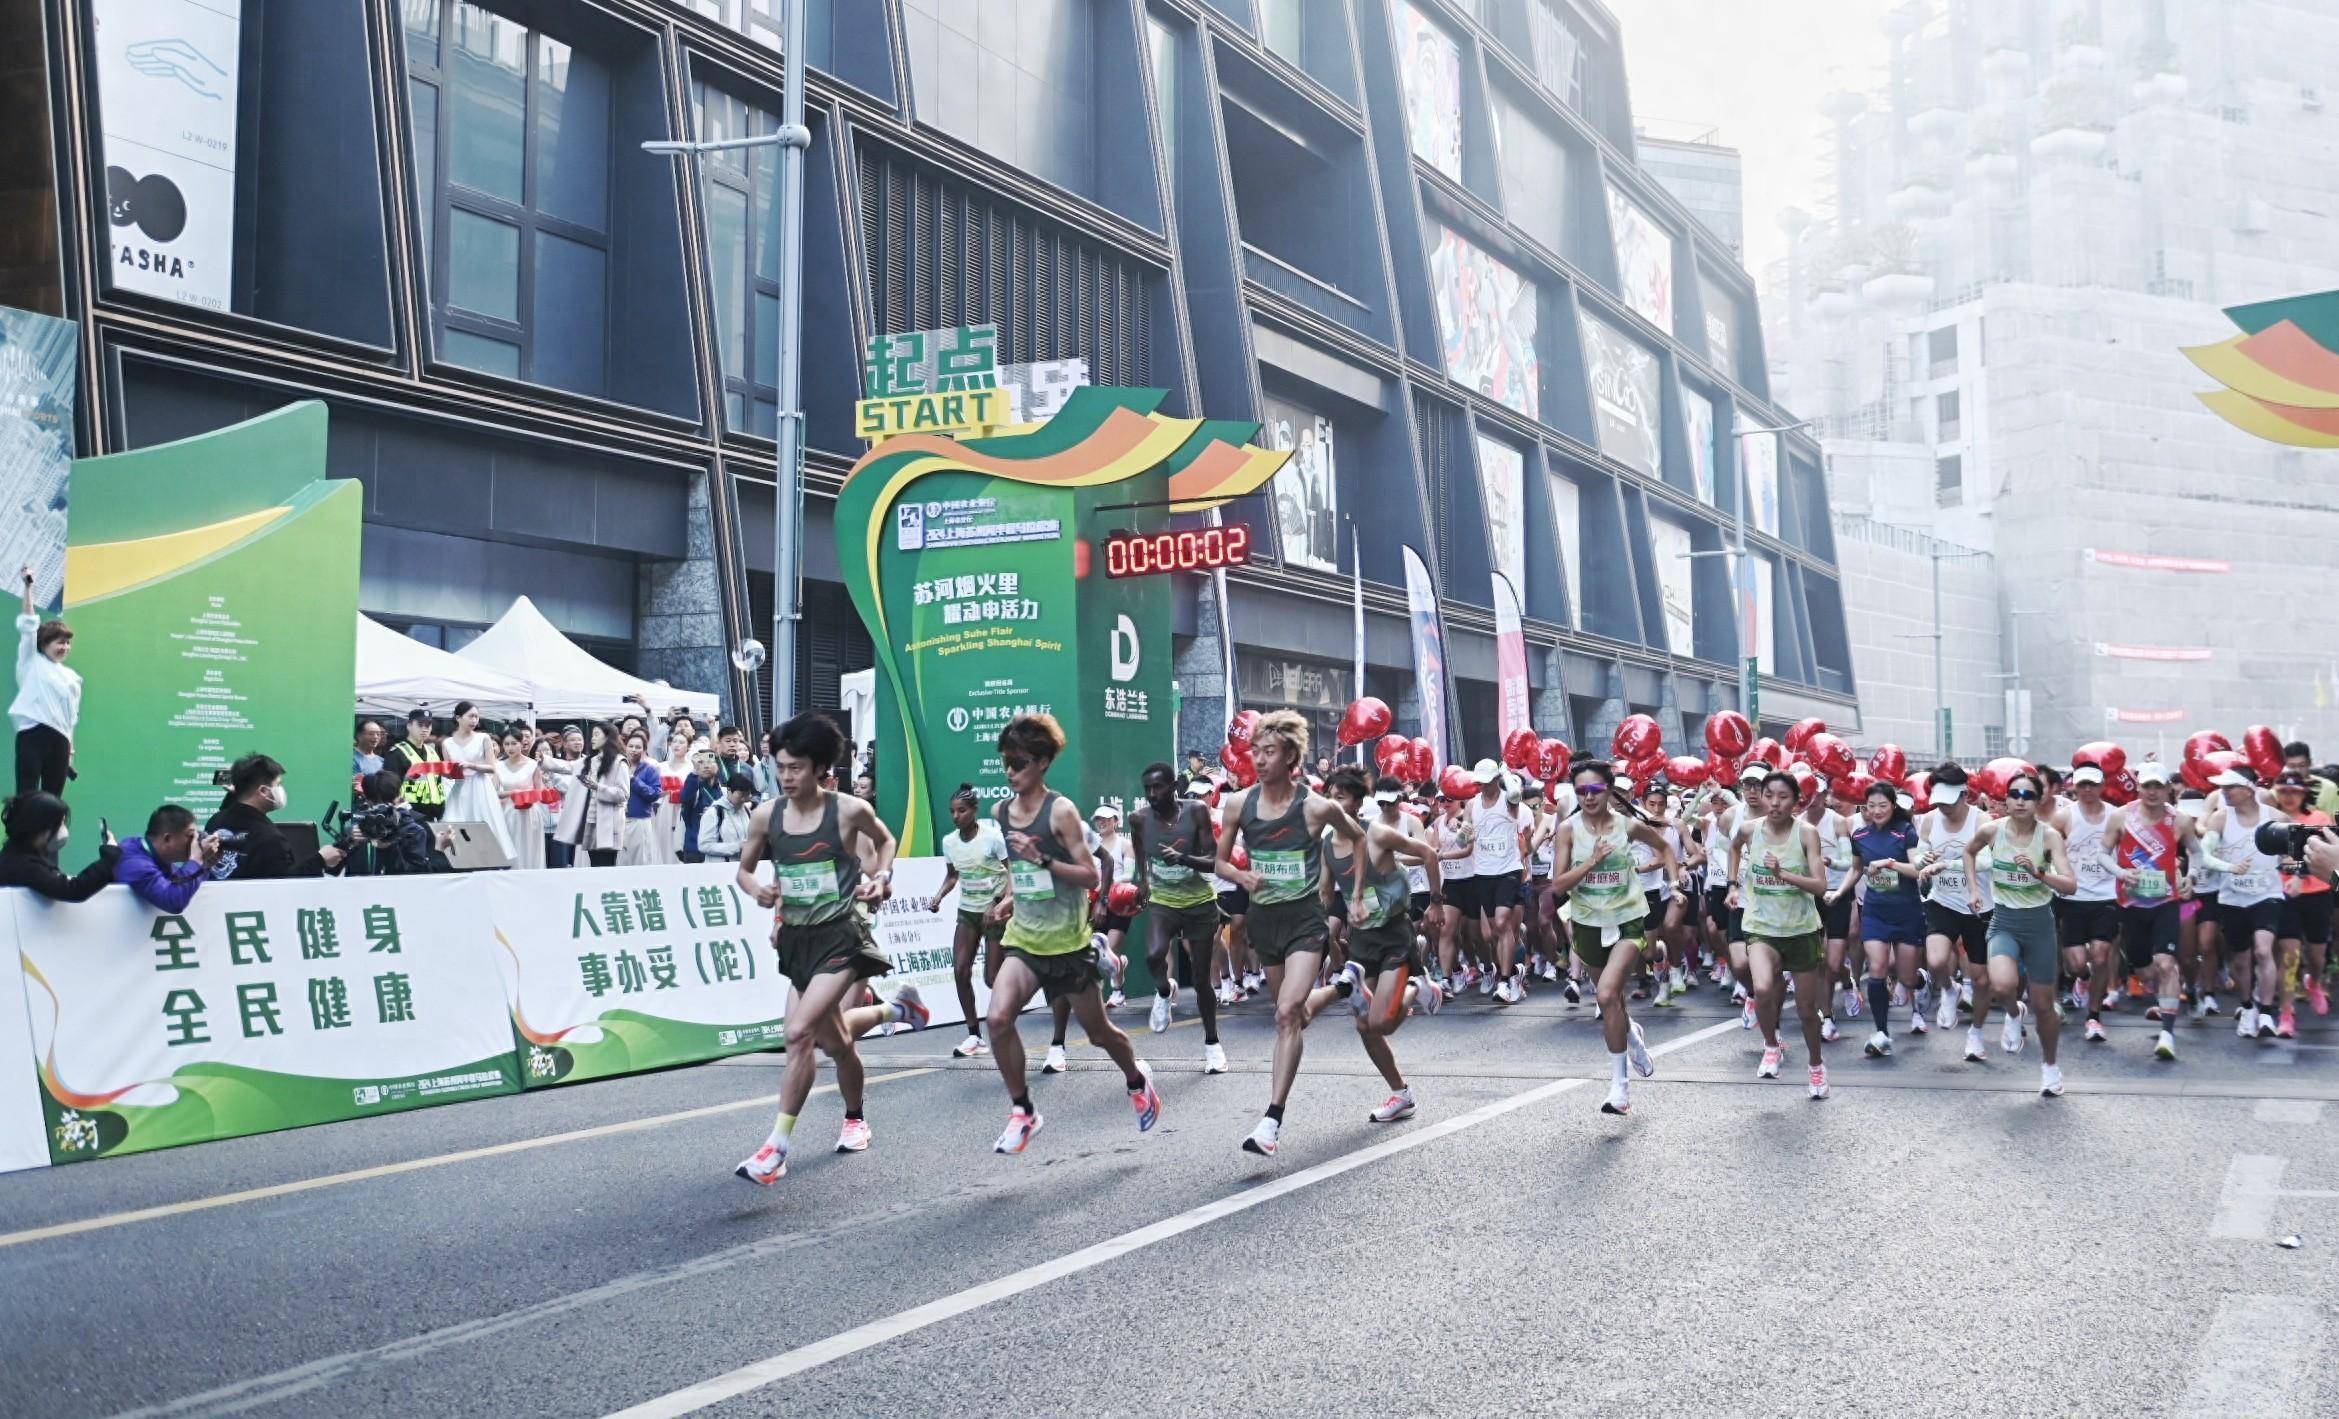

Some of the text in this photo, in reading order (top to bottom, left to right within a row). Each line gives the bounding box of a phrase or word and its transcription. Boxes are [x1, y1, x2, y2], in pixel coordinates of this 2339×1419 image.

[111, 245, 184, 278] ASHA
[866, 326, 998, 400] 起点
[863, 392, 993, 432] START
[1108, 528, 1245, 575] 00:00:02
[913, 572, 1018, 605] 苏河烟火里
[905, 626, 1014, 652] Astonishing Suhe Flair
[938, 638, 1062, 656] Sparkling Shanghai Spirit
[1105, 687, 1148, 713] 东浩兰生
[1939, 877, 1958, 887] PACE
[2081, 864, 2101, 873] PACE
[150, 904, 403, 971] 全民健身
[578, 938, 756, 998] 事办妥（陀）
[161, 972, 416, 1047] 全民健康
